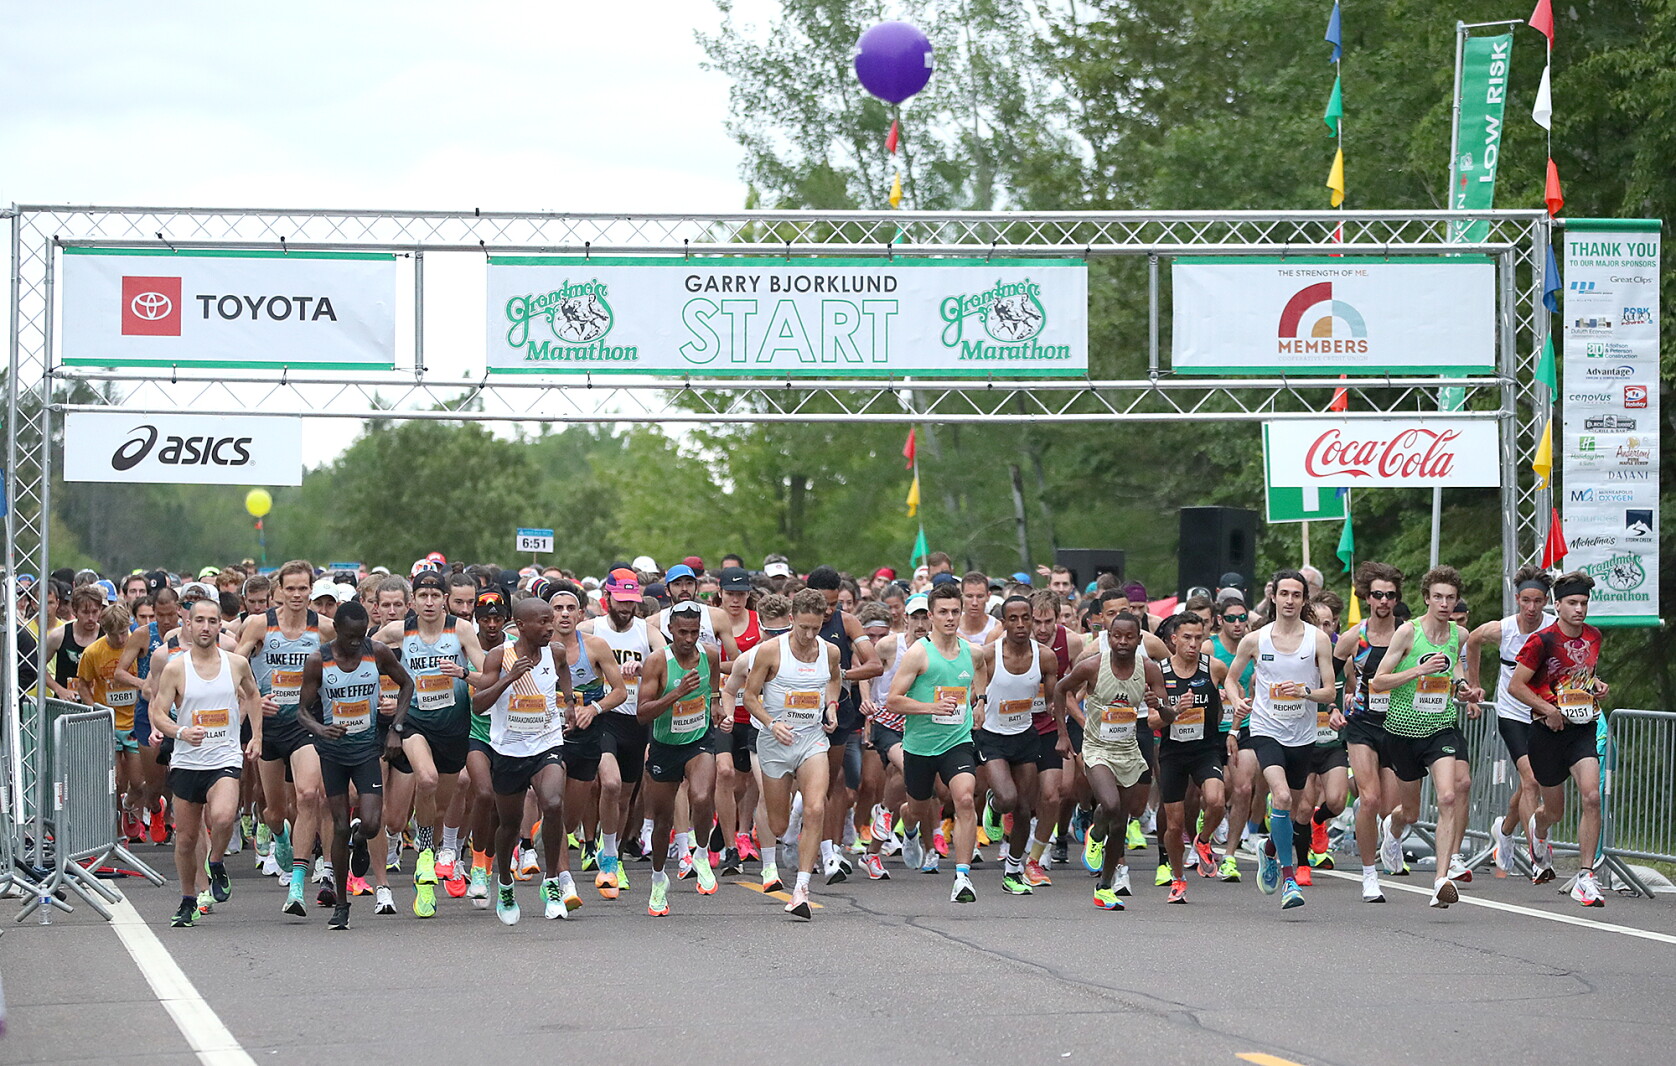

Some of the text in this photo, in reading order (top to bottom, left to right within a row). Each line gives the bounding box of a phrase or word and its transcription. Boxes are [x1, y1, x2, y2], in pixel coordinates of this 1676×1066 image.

[1479, 41, 1508, 182] LOW RISK
[1570, 242, 1657, 257] THANK YOU
[685, 275, 897, 292] GARRY BJORKLUND
[1633, 276, 1652, 284] Clips
[196, 295, 337, 321] TOYOTA
[679, 298, 898, 364] START
[526, 339, 638, 360] Marathon
[960, 338, 1071, 360] Marathon
[1278, 340, 1368, 353] MEMBERS
[1586, 368, 1631, 376] Advantage
[1569, 394, 1612, 403] cenovus
[158, 436, 253, 465] asics
[1305, 429, 1463, 478] Coca-Cola
[1609, 471, 1648, 480] DASANI
[522, 538, 546, 549] 6:51
[1570, 537, 1615, 549] Michelina's
[1591, 590, 1649, 602] Marathon
[266, 653, 287, 665] LAKE
[109, 692, 133, 701] 12681
[326, 683, 376, 699] LAKE EFFECT
[422, 693, 449, 702] BEHLING
[1566, 708, 1588, 717] 12151
[204, 731, 226, 739] LLANT
